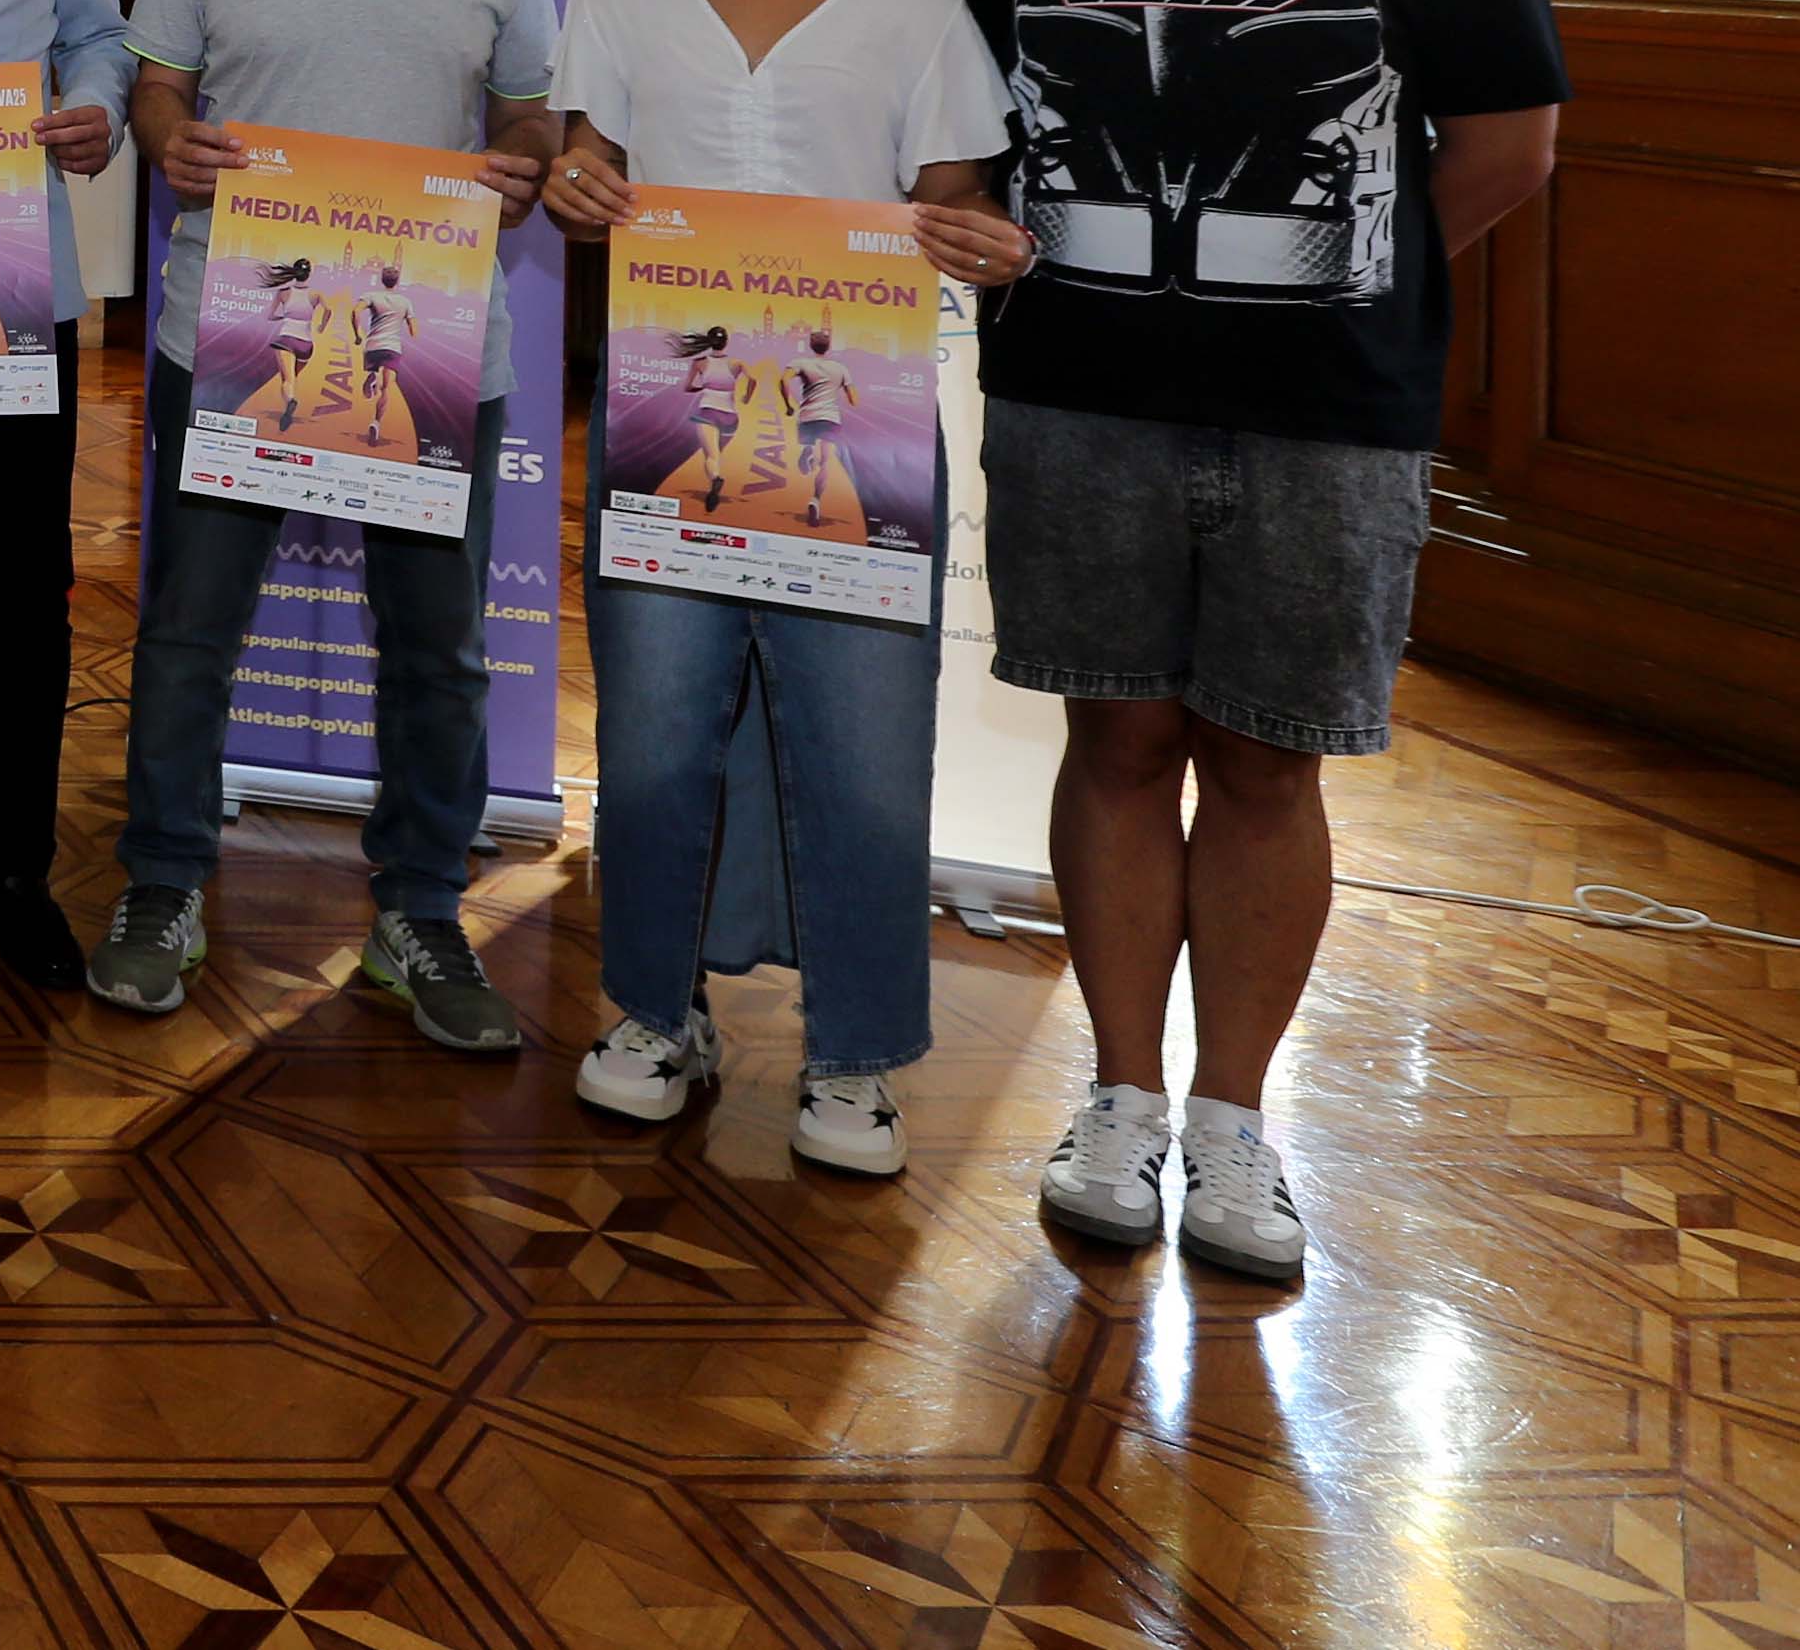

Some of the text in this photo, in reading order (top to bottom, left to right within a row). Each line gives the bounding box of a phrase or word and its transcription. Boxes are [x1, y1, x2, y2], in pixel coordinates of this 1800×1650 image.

[20, 205, 38, 215] 28
[328, 191, 383, 211] XXXVI
[230, 194, 479, 249] MEDIA MARATÓN
[738, 252, 803, 271] XXXVI
[231, 285, 273, 303] Legua
[629, 261, 733, 291] MEDIA
[744, 270, 917, 309] MARATÓN
[211, 297, 264, 314] Popular
[455, 308, 475, 321] 28
[642, 355, 688, 373] Legua
[620, 368, 680, 386] Popular
[899, 372, 923, 387] 28
